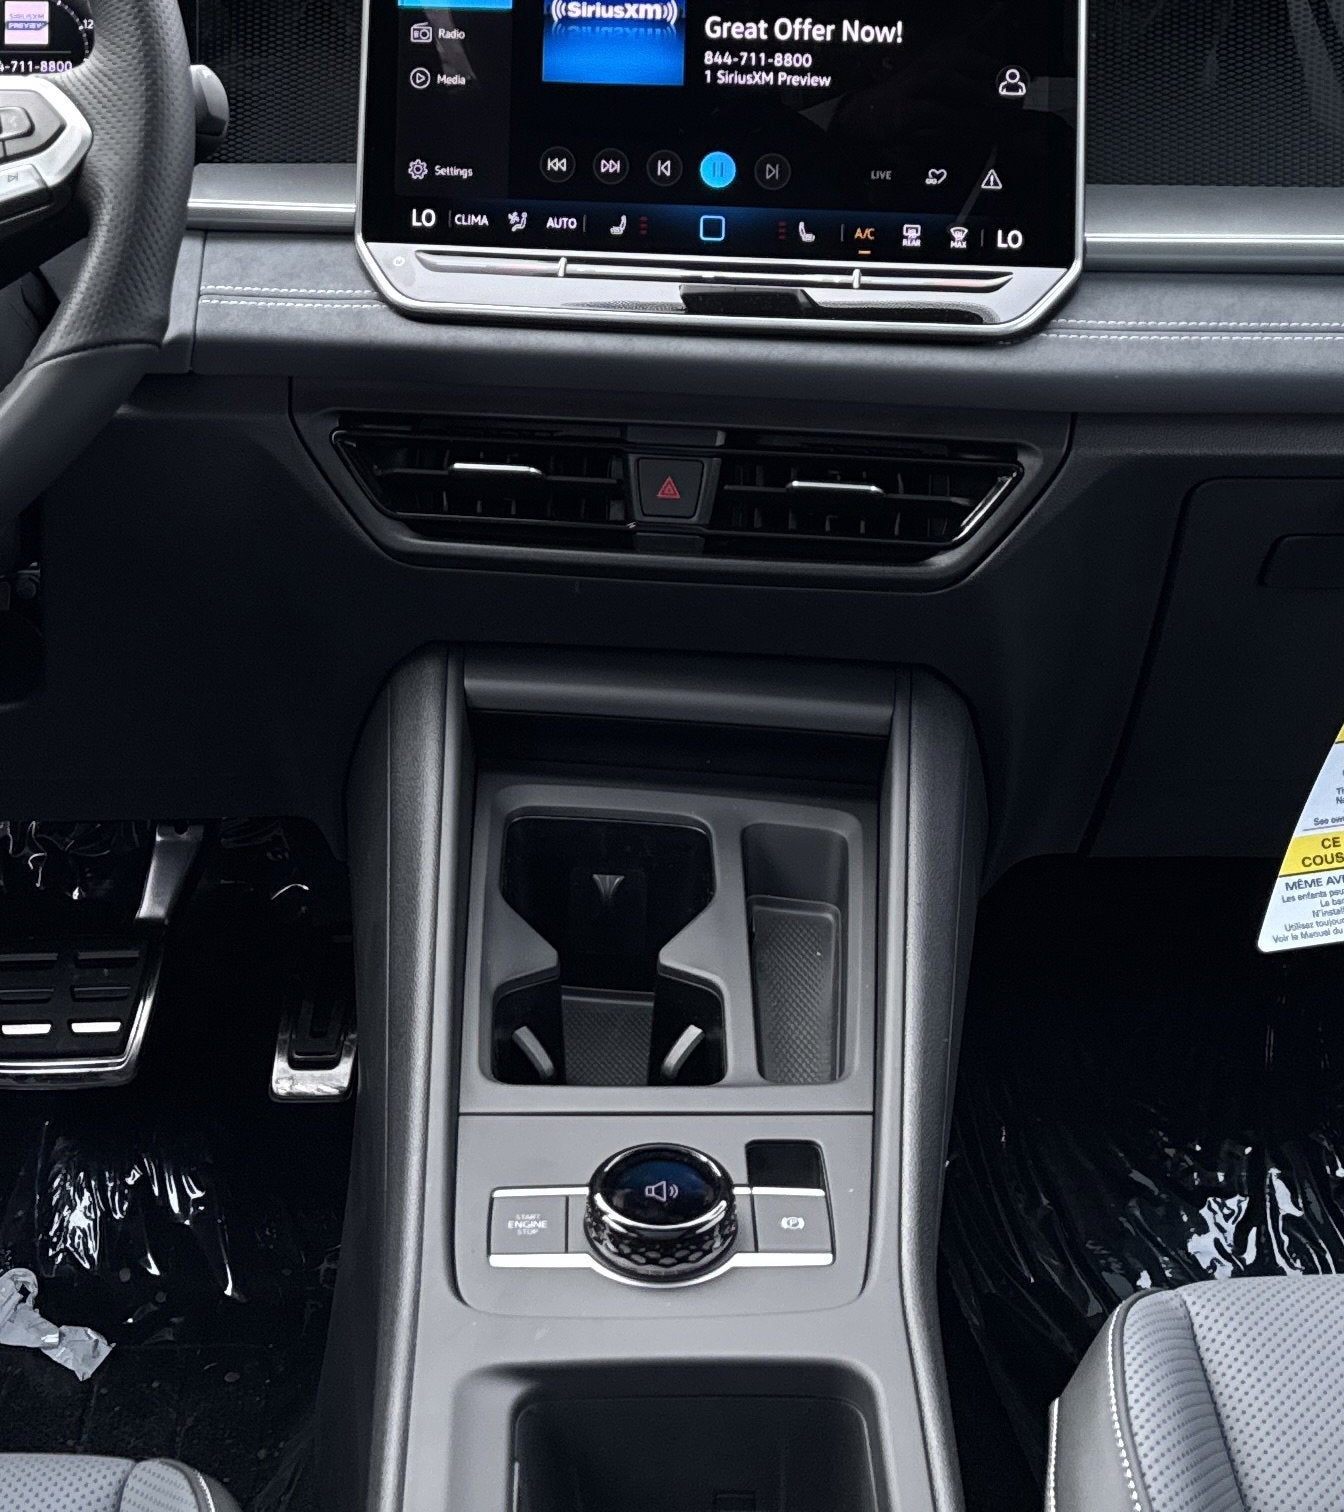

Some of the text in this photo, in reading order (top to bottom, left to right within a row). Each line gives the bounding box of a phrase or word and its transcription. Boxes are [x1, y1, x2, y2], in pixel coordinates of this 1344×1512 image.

[438, 28, 465, 40] Radio
[705, 16, 904, 43] Great Offer Now!
[704, 51, 813, 68] 844-711-8800
[437, 73, 466, 85] Media
[705, 70, 832, 89] 1 SiriusXM Preview
[434, 164, 473, 178] Settings
[870, 170, 892, 180] LIVE
[411, 208, 436, 227] LO
[454, 213, 489, 226] CLIMA
[546, 216, 577, 230] AUTO
[854, 228, 875, 240] A/C
[996, 230, 1023, 248] LO
[902, 239, 921, 247] REAR
[950, 240, 967, 248] MAX
[1321, 837, 1342, 850] CE
[1285, 877, 1324, 891] MÊME
[508, 1220, 547, 1228] ENGINE
